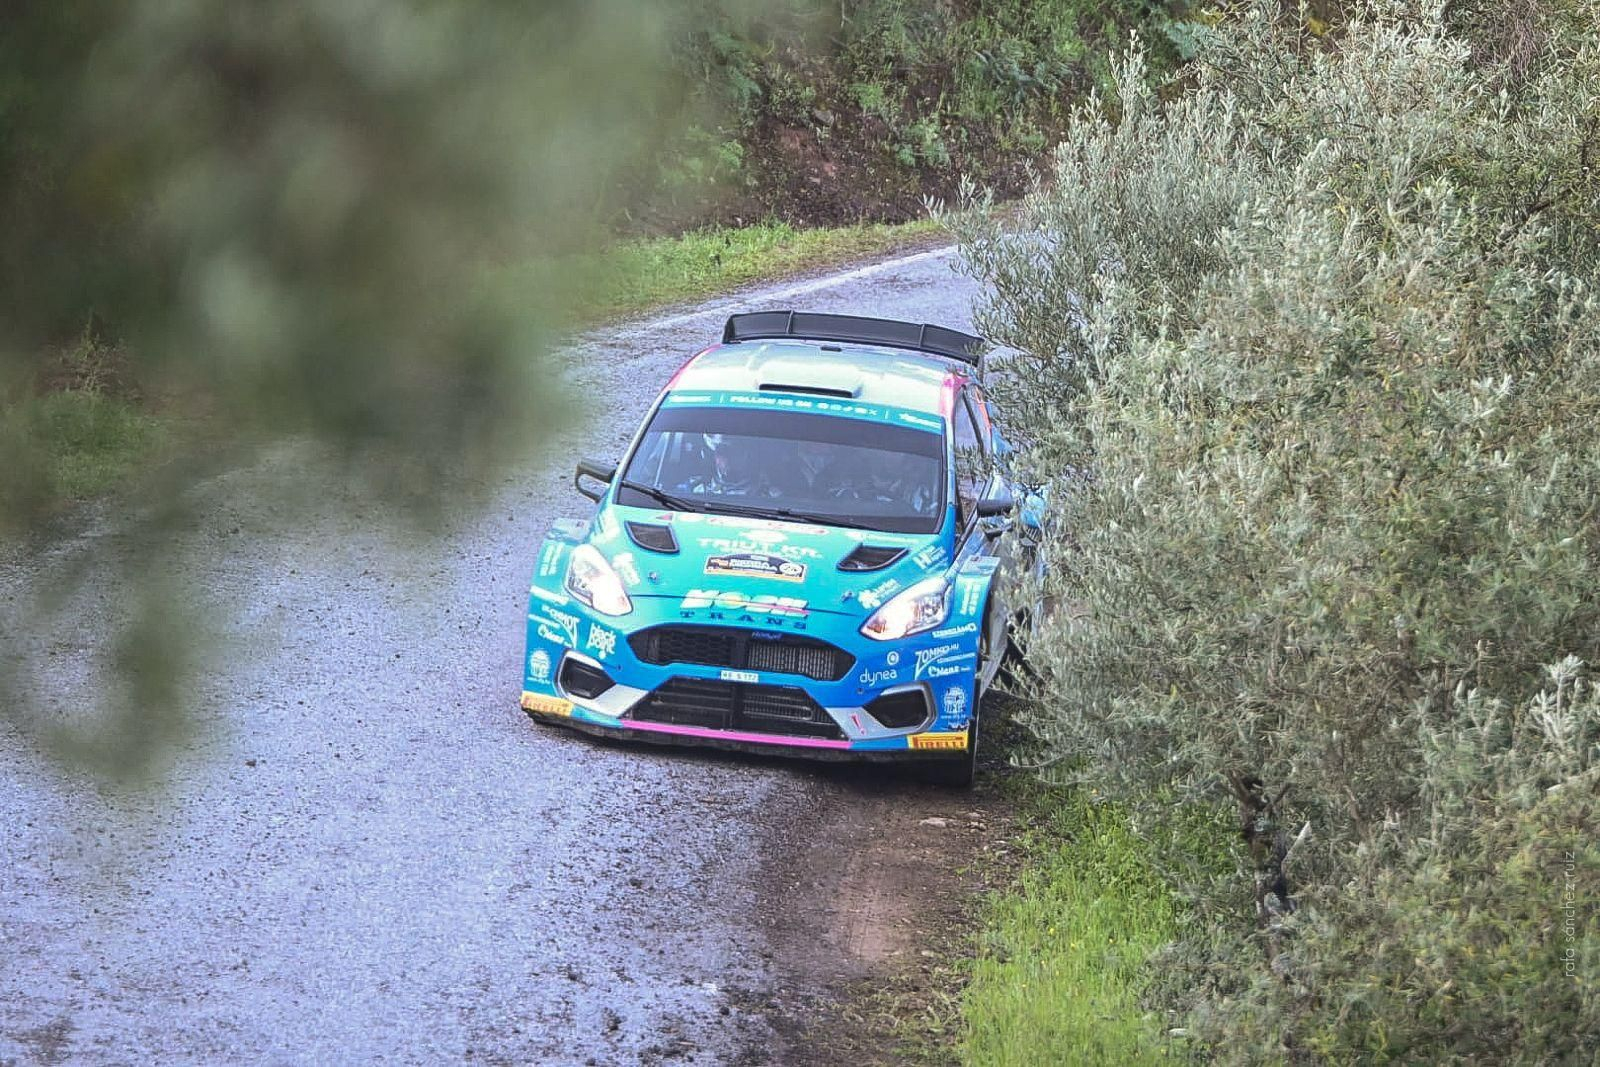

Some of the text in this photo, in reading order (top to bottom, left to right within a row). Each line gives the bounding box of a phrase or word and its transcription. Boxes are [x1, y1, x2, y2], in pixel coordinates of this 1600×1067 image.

[679, 610, 807, 630] TRANS
[859, 668, 898, 687] dynea
[912, 736, 967, 749] PIRELLI
